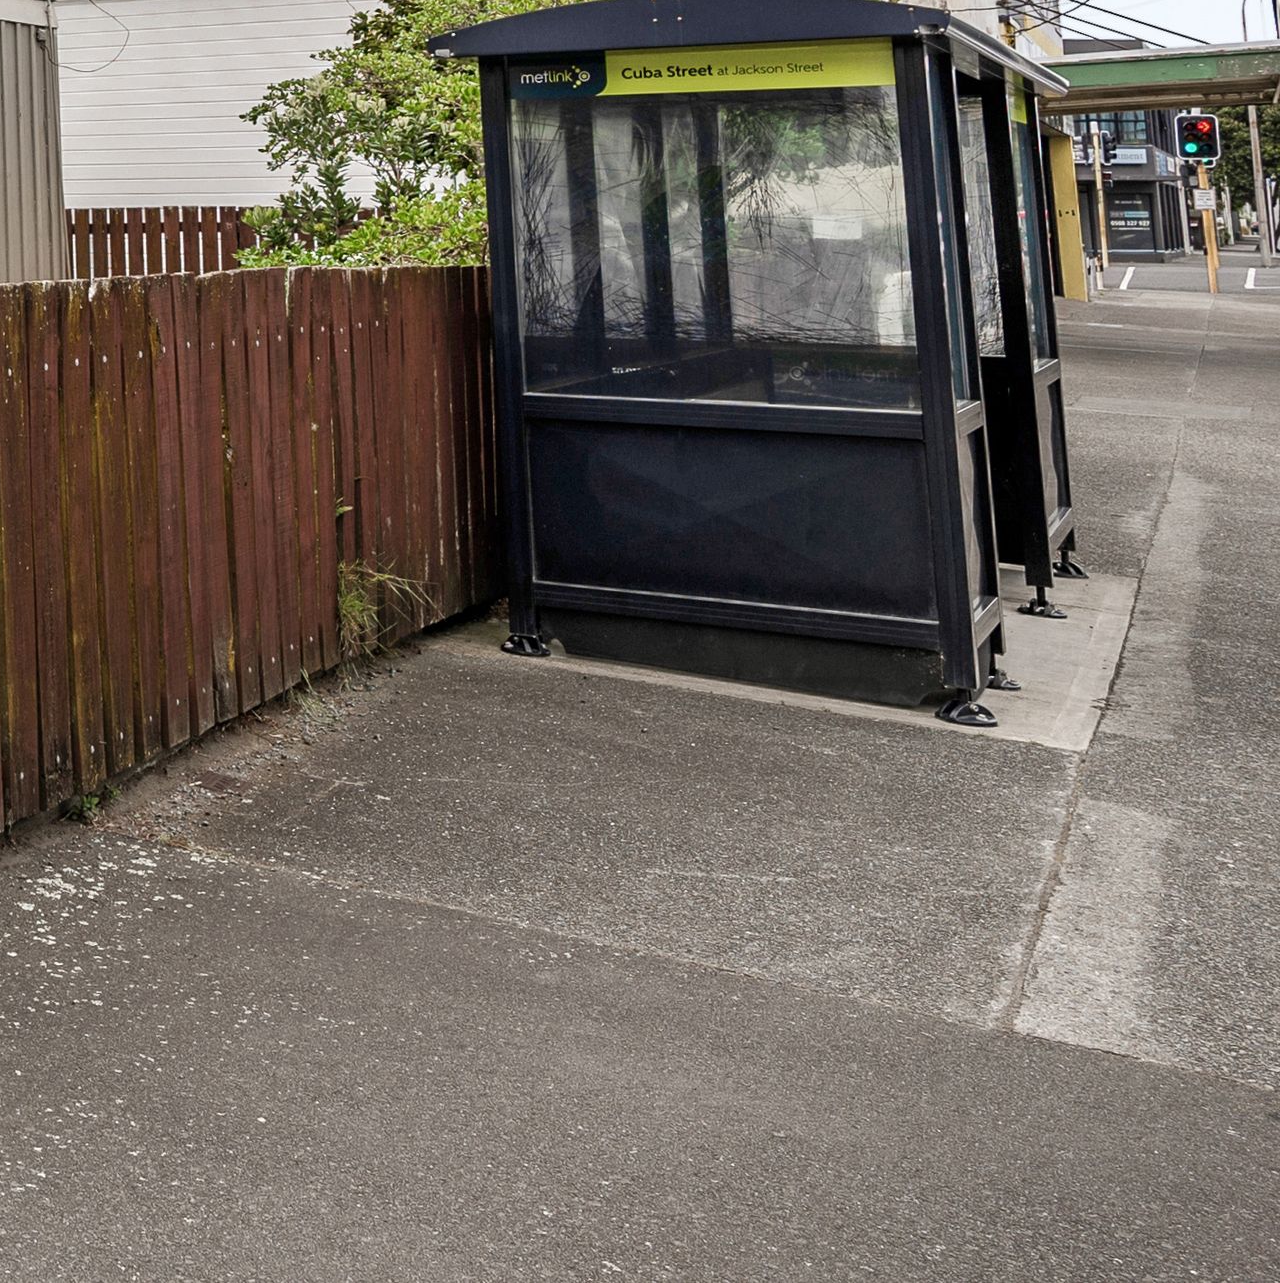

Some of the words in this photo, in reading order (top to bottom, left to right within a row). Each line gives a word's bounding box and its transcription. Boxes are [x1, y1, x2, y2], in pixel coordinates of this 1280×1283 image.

[520, 70, 573, 84] metlink
[621, 66, 663, 80] Cuba
[667, 64, 714, 78] Street
[717, 66, 729, 76] at
[732, 64, 784, 76] Jackson
[786, 62, 824, 74] Street
